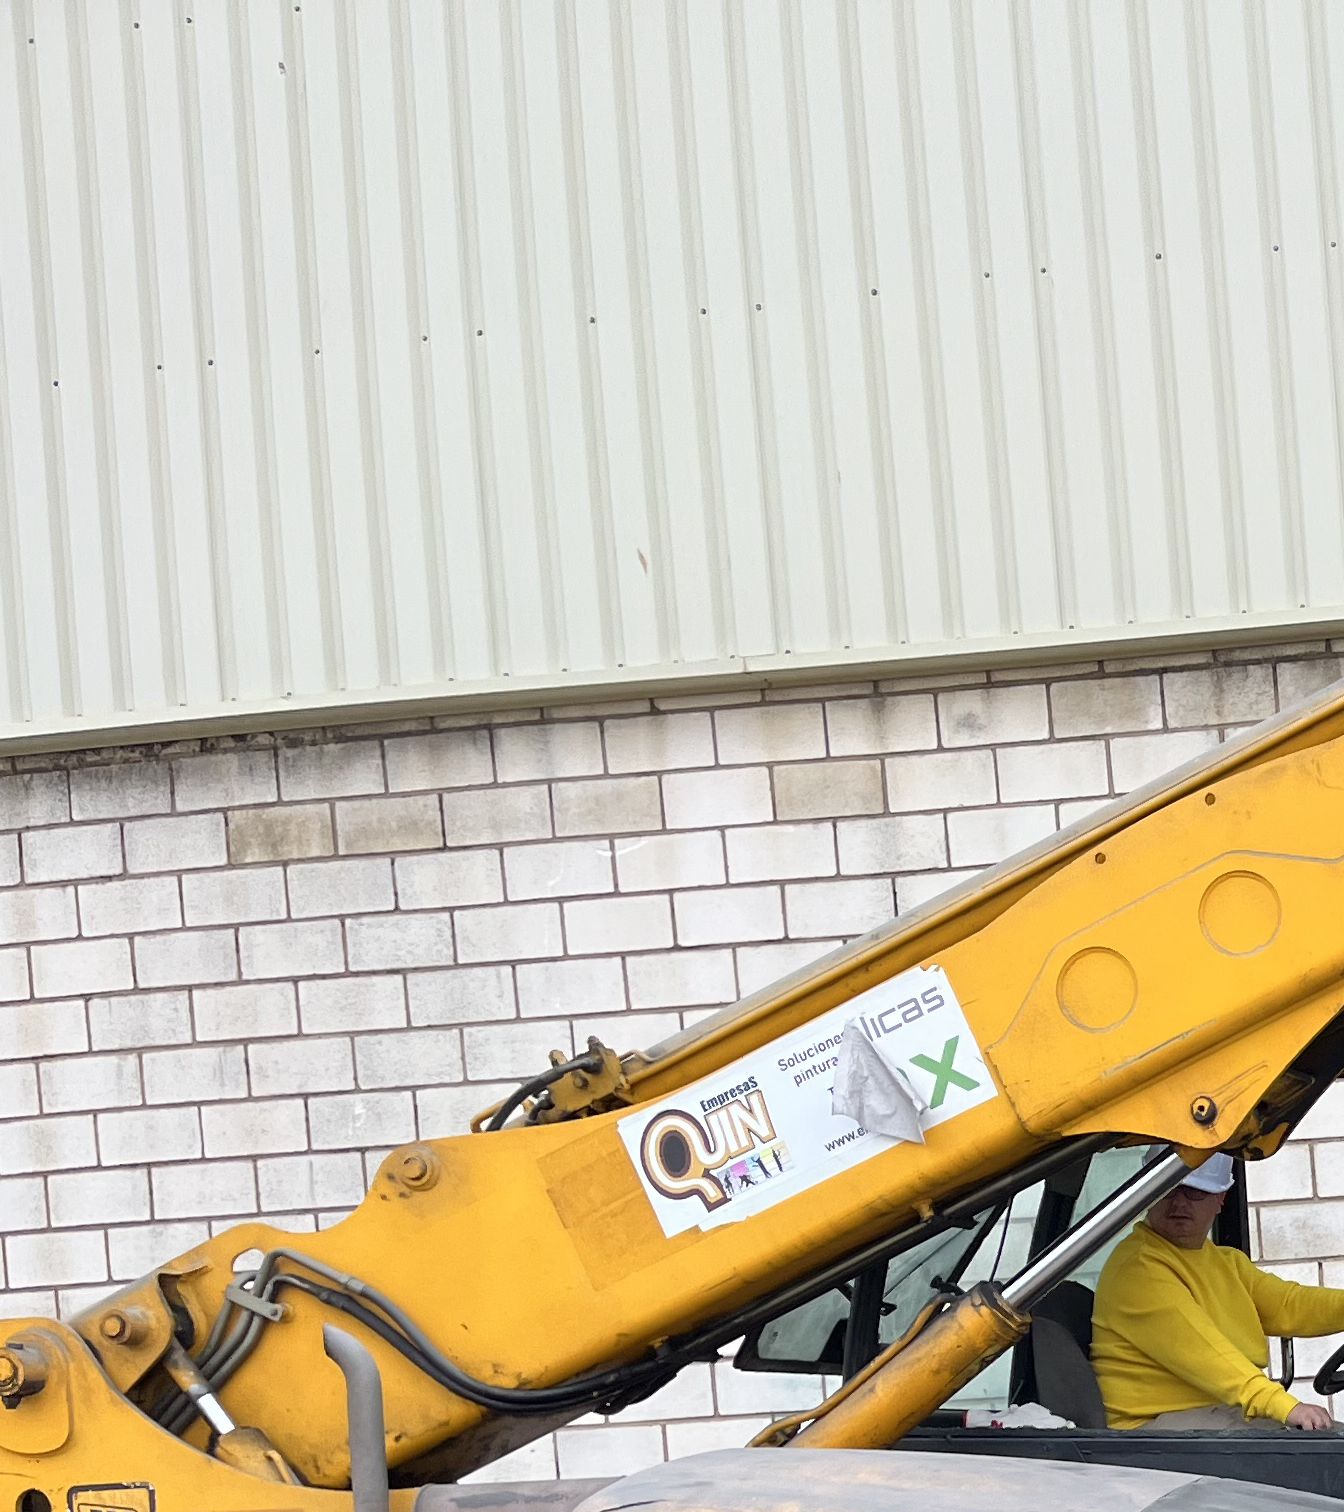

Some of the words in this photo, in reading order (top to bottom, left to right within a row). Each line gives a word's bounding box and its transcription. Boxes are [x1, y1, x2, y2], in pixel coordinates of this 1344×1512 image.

[860, 986, 945, 1042] licas
[640, 1089, 777, 1213] QUIN
[824, 1127, 871, 1152] www.e
